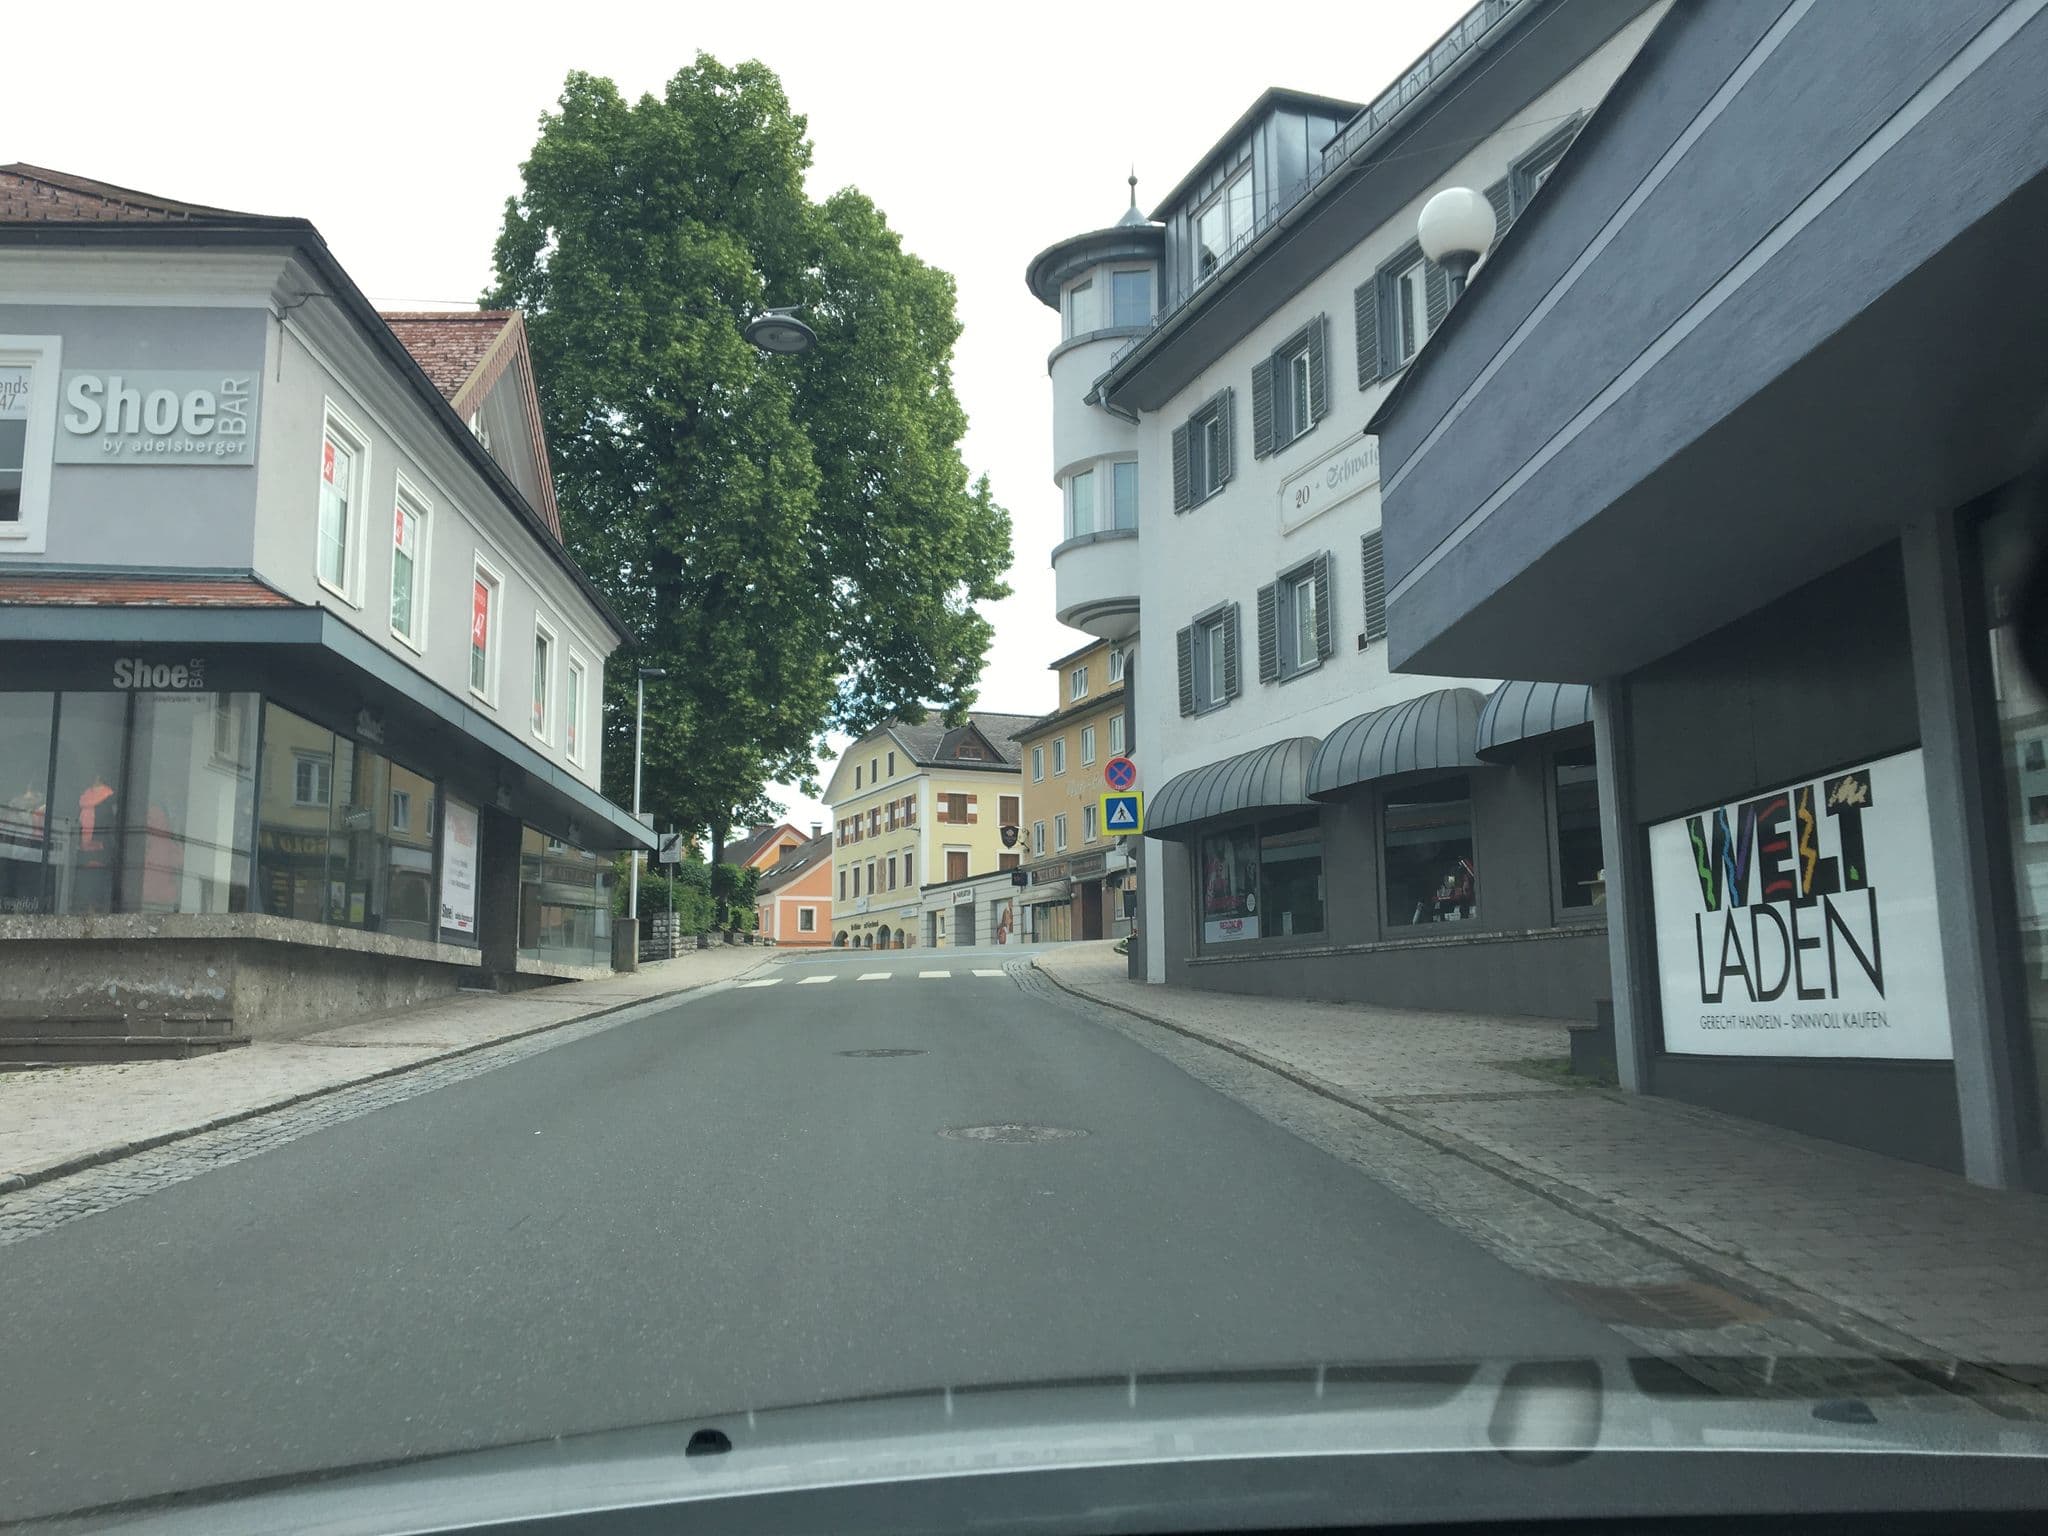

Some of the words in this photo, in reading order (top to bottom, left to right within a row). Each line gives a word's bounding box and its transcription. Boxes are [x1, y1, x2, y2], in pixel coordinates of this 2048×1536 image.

[63, 375, 217, 435] Shoe
[218, 377, 250, 435] BAR
[103, 438, 122, 454] by
[132, 438, 246, 456] adelsberger
[1296, 485, 1310, 508] 20
[113, 657, 188, 689] Shoe
[188, 658, 205, 688] BAR
[1685, 769, 1873, 912] WELT
[1695, 886, 1885, 1003] LADEN
[1700, 1015, 1736, 1030] GERECHT
[1738, 1015, 1781, 1030] HANDELN
[1791, 1013, 1840, 1029] SINNVOLL
